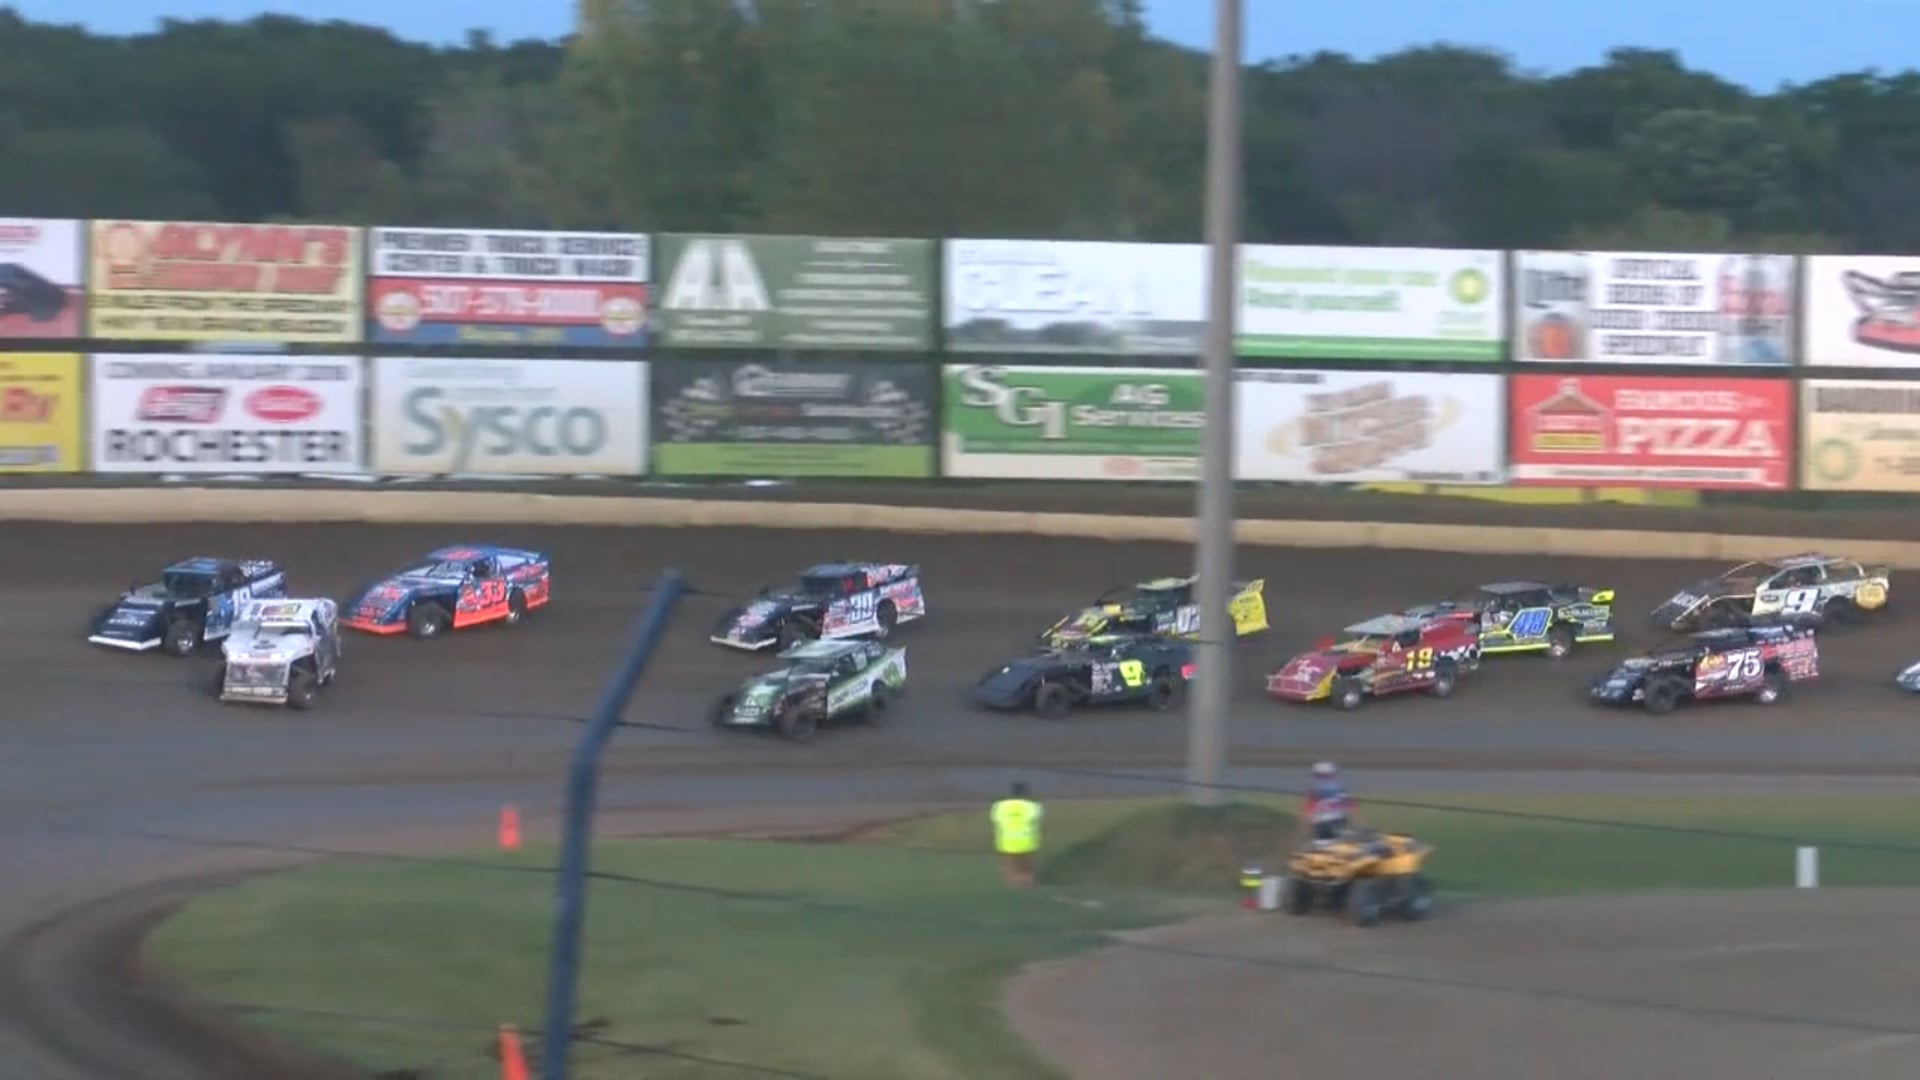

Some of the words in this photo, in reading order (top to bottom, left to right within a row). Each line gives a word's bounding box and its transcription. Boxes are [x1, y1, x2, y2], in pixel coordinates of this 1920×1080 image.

[960, 364, 1068, 440] SGI
[1110, 384, 1170, 405] AG
[400, 387, 607, 471] Sysco
[1070, 404, 1206, 428] Services
[105, 430, 351, 463] ROCHESTER
[1615, 417, 1782, 457] PIZZA
[1782, 589, 1818, 615] 9
[1512, 609, 1548, 636] 48
[1119, 660, 1144, 687] 9
[1727, 650, 1762, 681] 75
